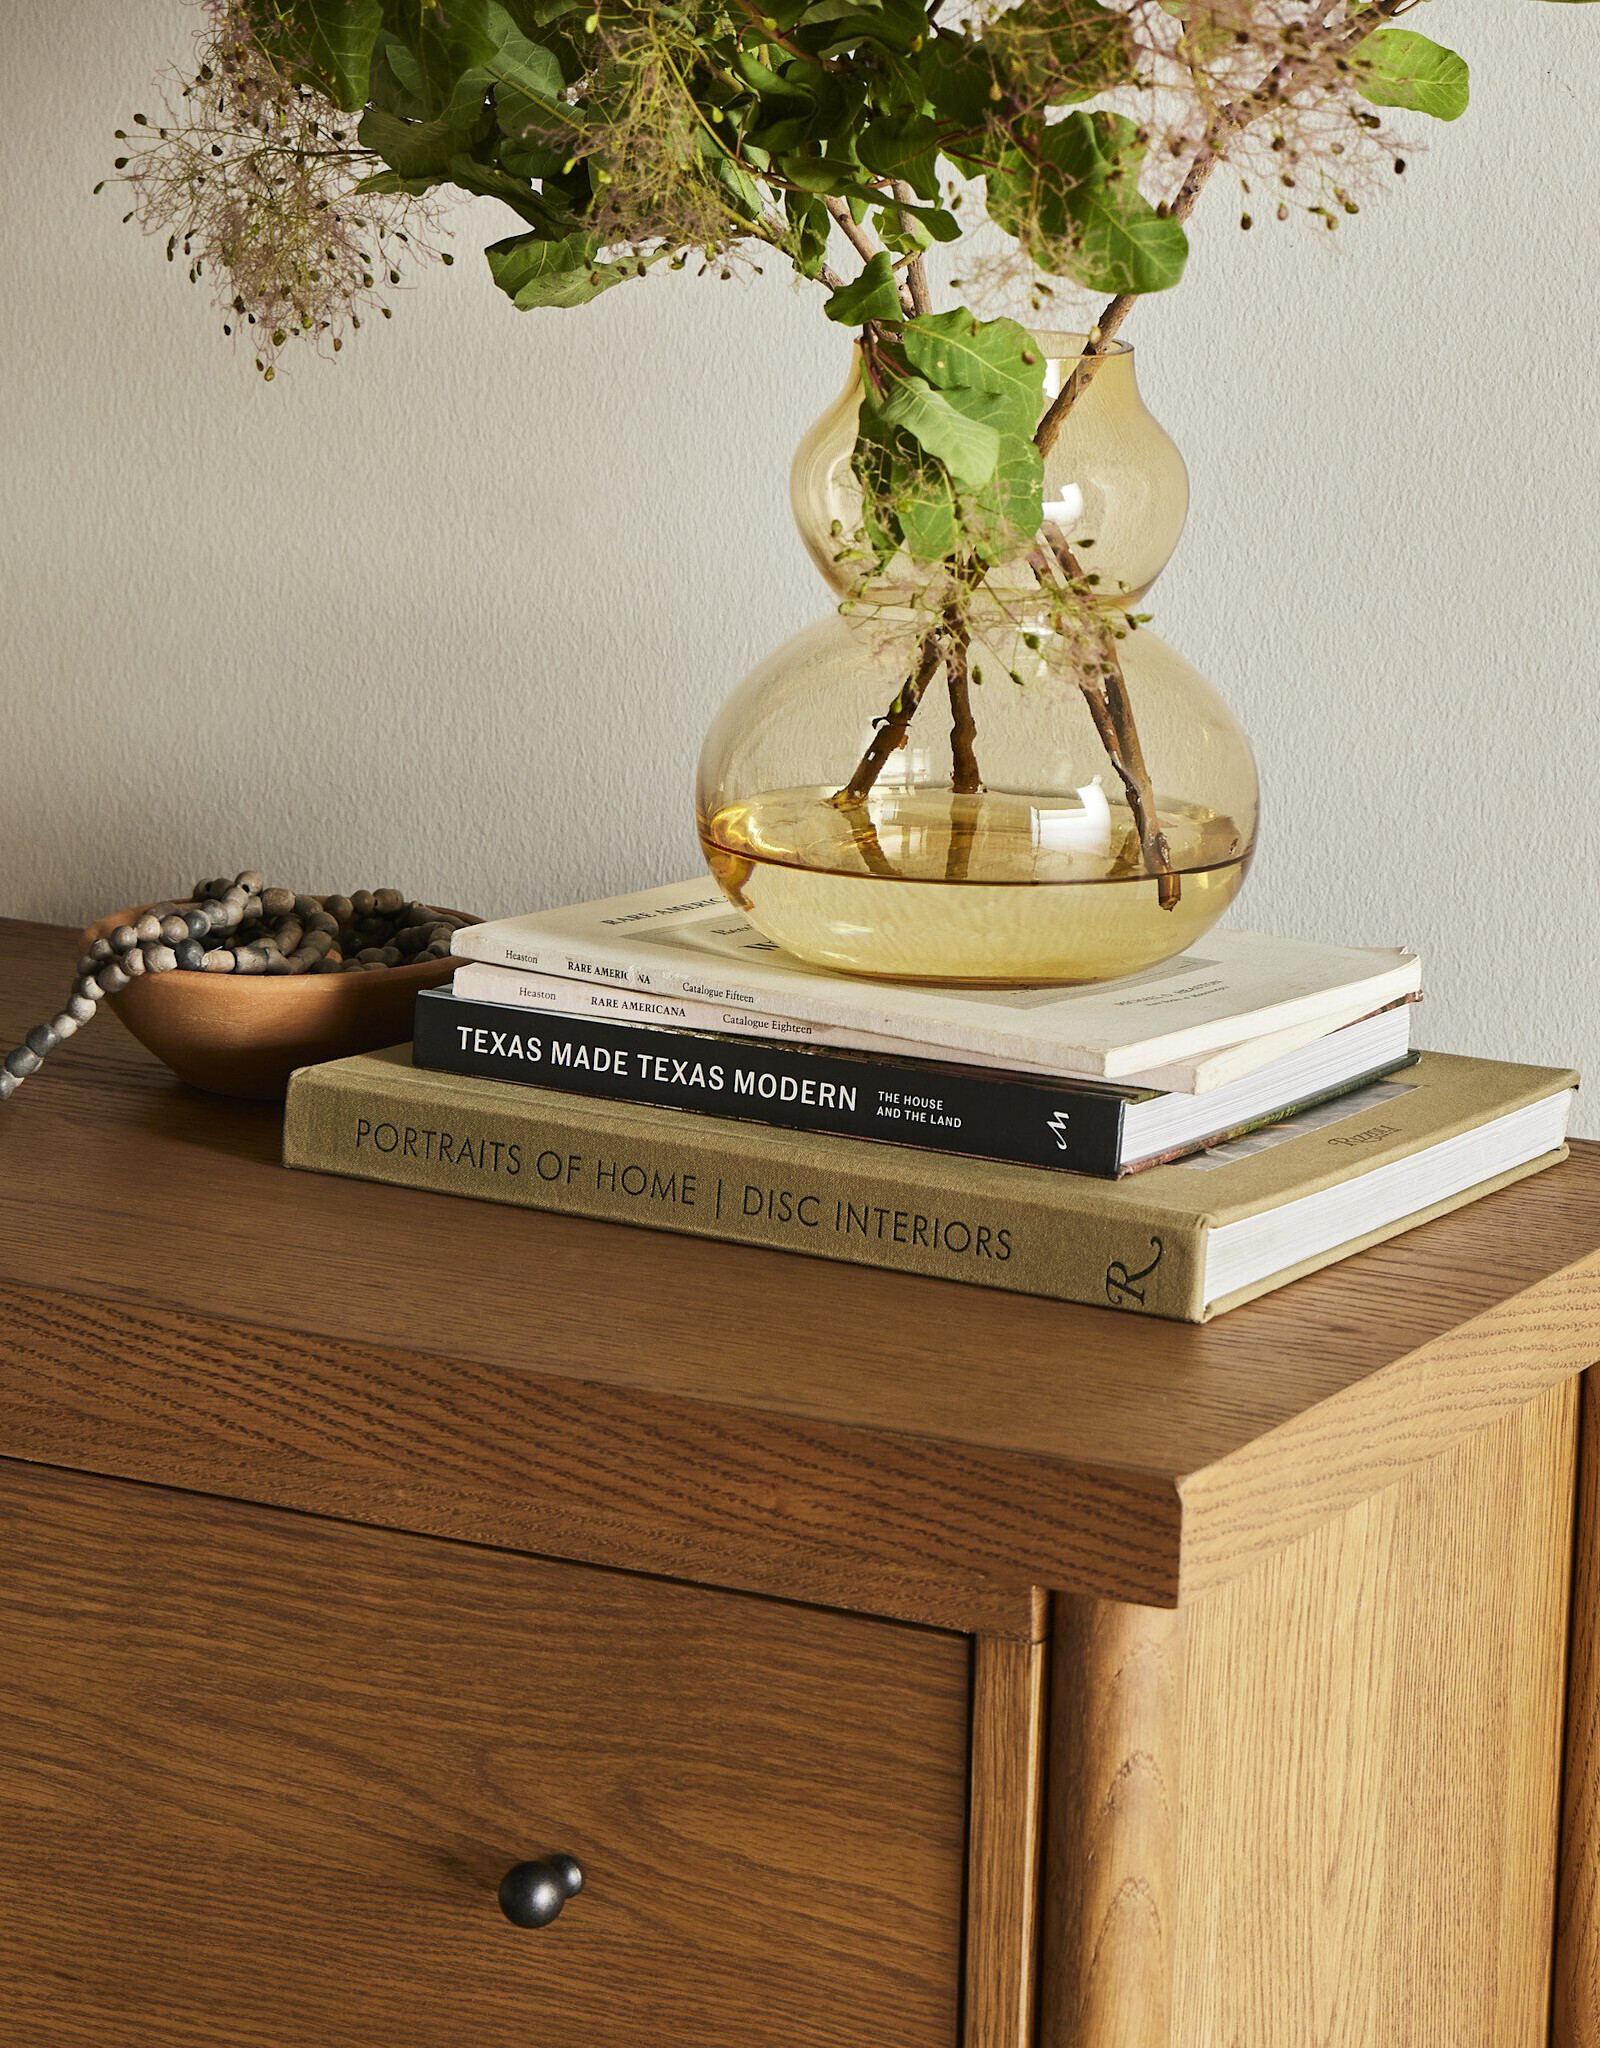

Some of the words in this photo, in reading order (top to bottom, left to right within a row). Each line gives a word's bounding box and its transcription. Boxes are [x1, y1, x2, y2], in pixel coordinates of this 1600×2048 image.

[601, 912, 656, 926] RARE
[505, 949, 539, 964] Heaston
[568, 960, 592, 975] RARE
[593, 965, 651, 985] AMERICNA
[682, 981, 724, 998] Catalogue
[725, 989, 754, 1004] Fifteen
[519, 986, 556, 1001] Heaston
[591, 996, 619, 1009] RARE
[621, 1000, 686, 1018] AMERICANA
[722, 1013, 769, 1030] Catalogue
[771, 1020, 812, 1035] Eighteen
[456, 1025, 542, 1062] TEXAS
[550, 1040, 629, 1076] MADE
[636, 1053, 724, 1091] TEXAS
[733, 1068, 858, 1112] MODERN
[876, 1105, 901, 1119] AND
[904, 1109, 927, 1123] THE
[929, 1113, 963, 1129] LAND
[877, 1090, 900, 1105] THE
[903, 1094, 944, 1111] HOUSE
[355, 1118, 521, 1175] PORTRAITS
[536, 1150, 582, 1184] OF
[596, 1159, 697, 1206] HOME
[743, 1184, 820, 1227] DISC
[835, 1201, 1013, 1262] INTERIORS
